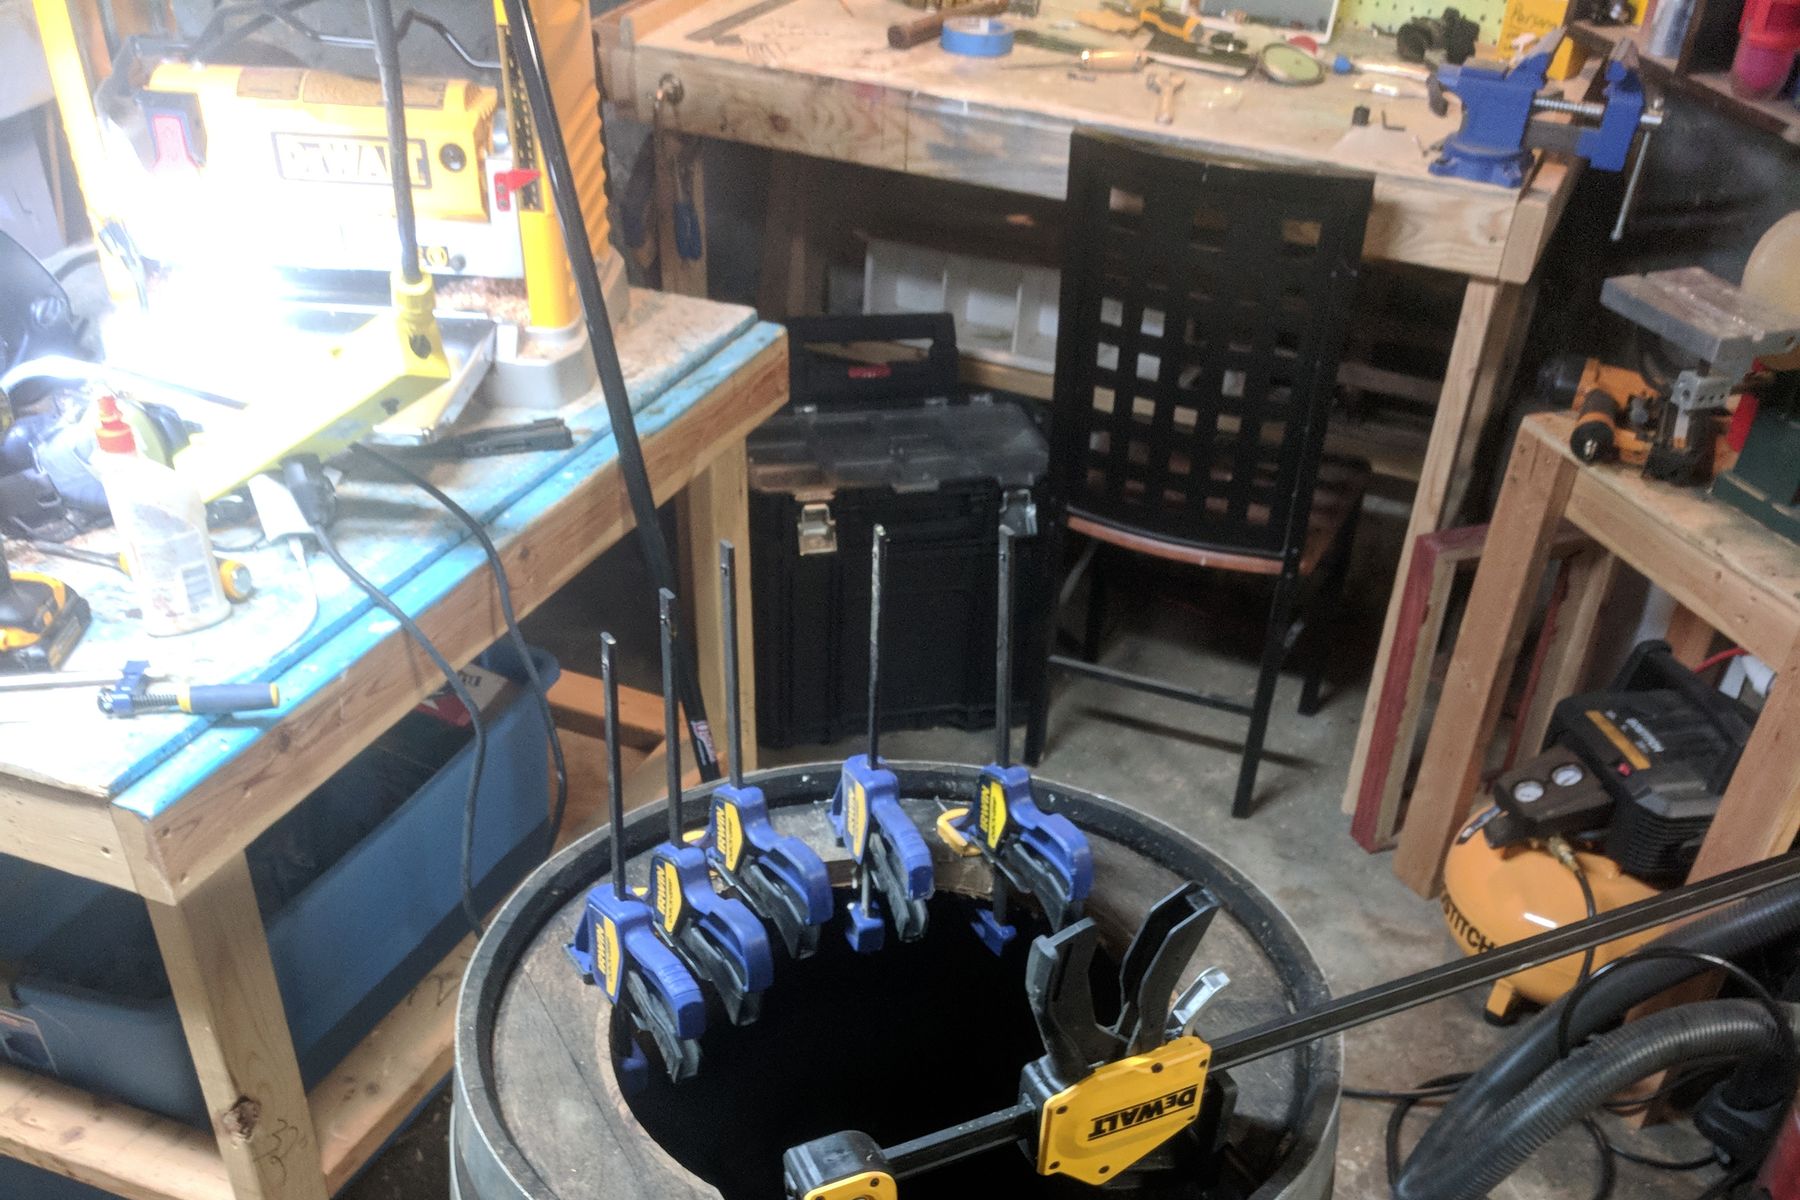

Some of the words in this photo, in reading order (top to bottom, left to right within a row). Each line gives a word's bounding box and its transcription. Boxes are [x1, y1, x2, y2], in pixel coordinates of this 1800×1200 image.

[716, 805, 726, 855] IRWIN
[980, 784, 990, 833] IRWIN
[656, 865, 666, 915] IRWIN
[1441, 884, 1495, 953] STITCH
[595, 923, 607, 975] IRWIN
[1088, 1086, 1198, 1139] DEWALT
